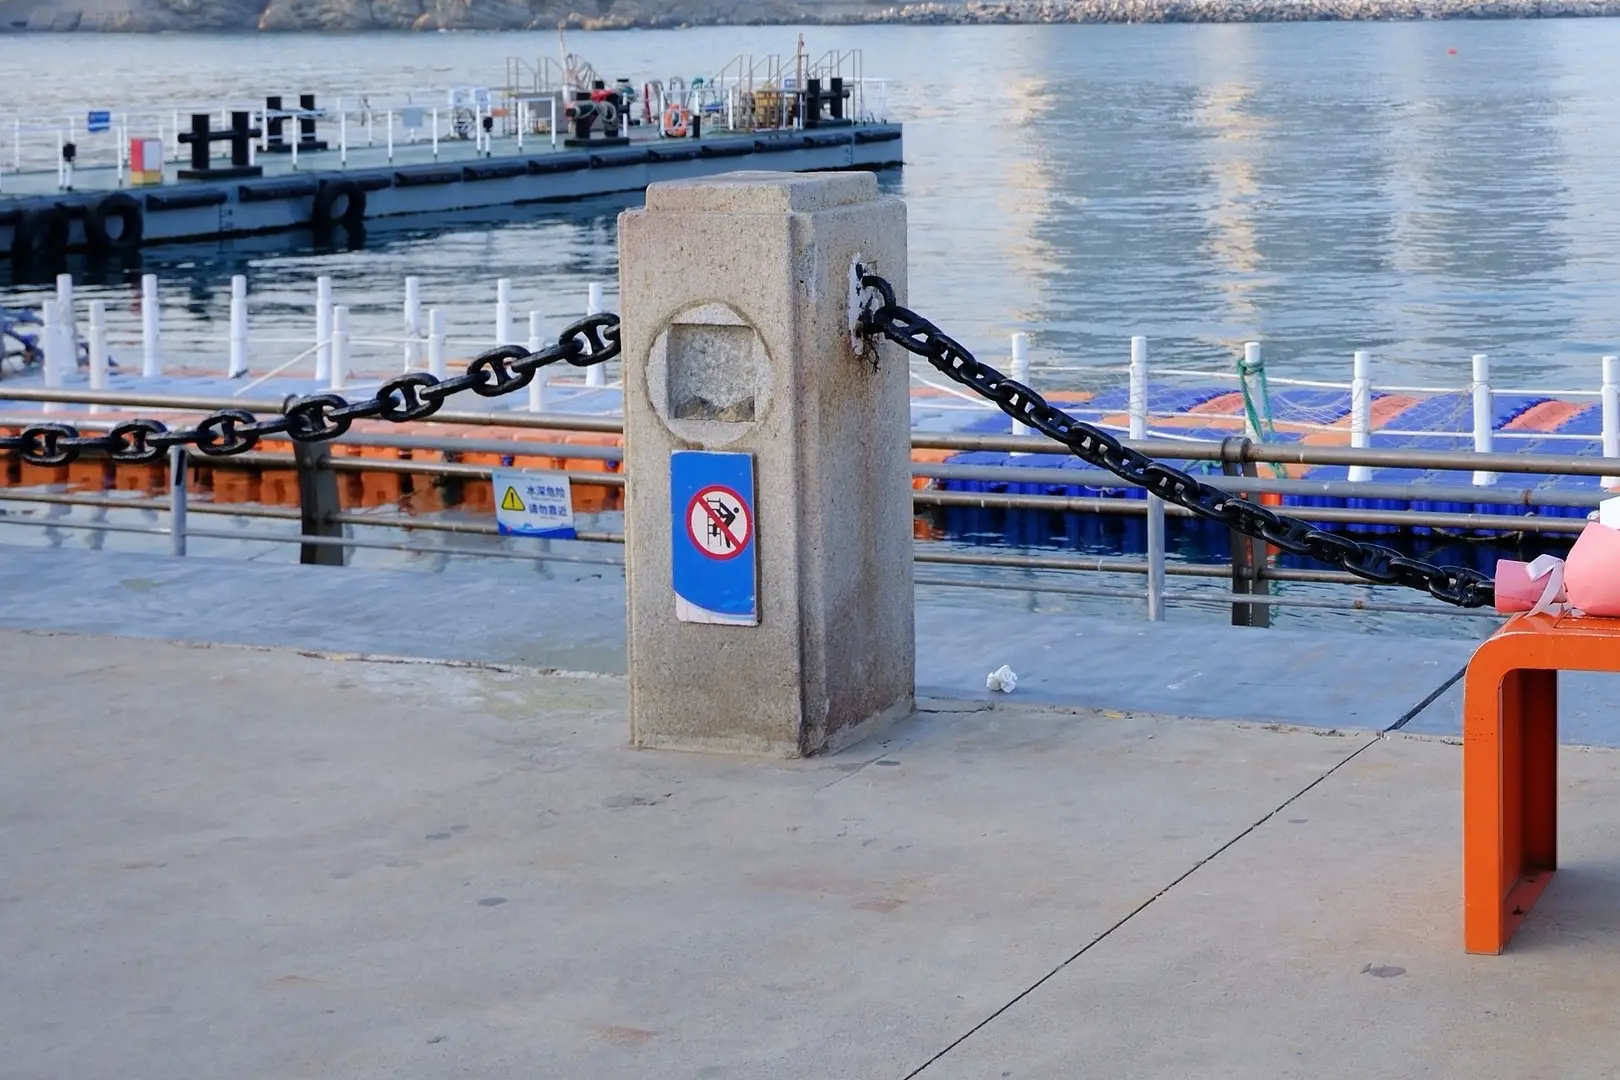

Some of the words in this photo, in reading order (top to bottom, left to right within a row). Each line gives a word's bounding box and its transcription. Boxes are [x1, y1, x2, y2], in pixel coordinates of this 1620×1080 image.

[526, 484, 566, 498] 水深危险
[528, 503, 568, 517] 请勿靠近
